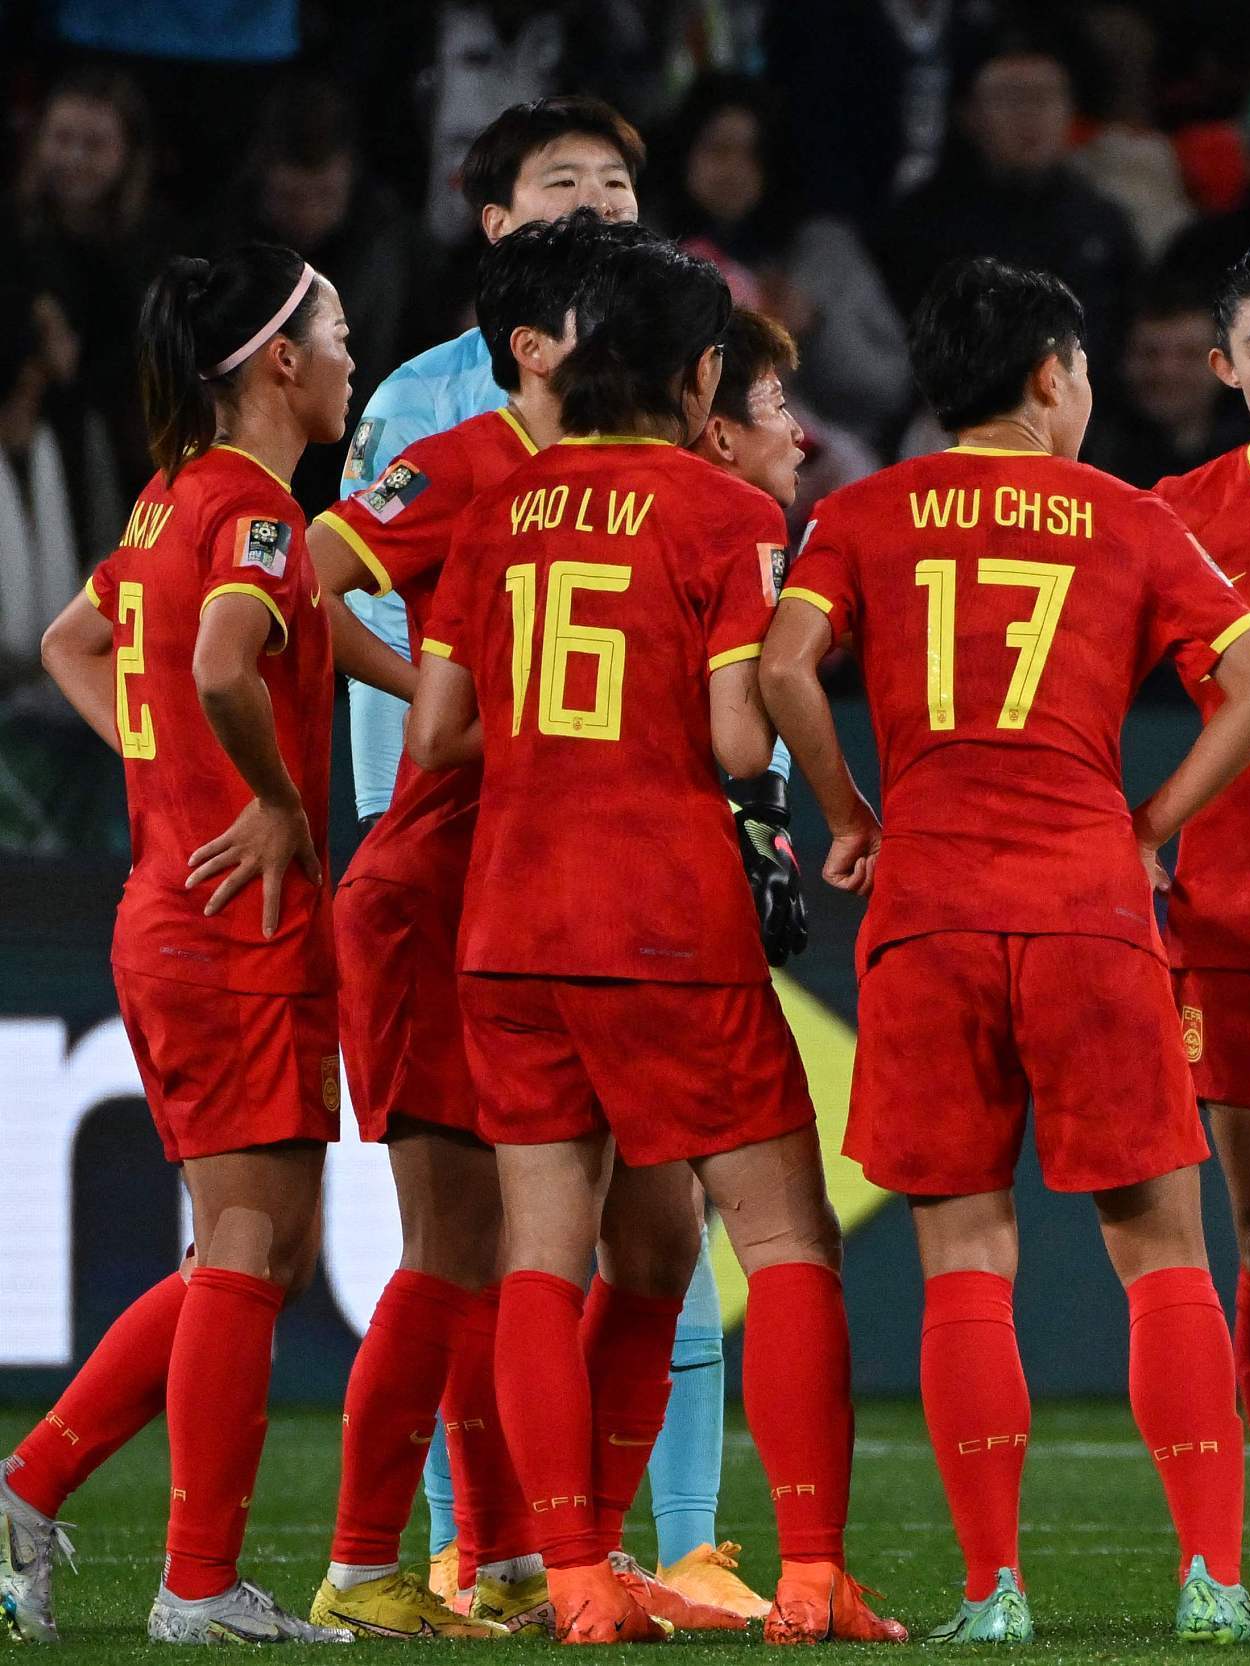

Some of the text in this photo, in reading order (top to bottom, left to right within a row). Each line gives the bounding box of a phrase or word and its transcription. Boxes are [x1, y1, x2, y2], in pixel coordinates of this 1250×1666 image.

[511, 485, 654, 536] YAO L W
[909, 488, 980, 528] WU
[505, 561, 632, 741] 16
[915, 558, 1076, 731] 17
[117, 581, 156, 760] 2
[959, 1434, 1026, 1455] CFA
[1153, 1441, 1218, 1461] CFA
[533, 1495, 587, 1512] CFA
